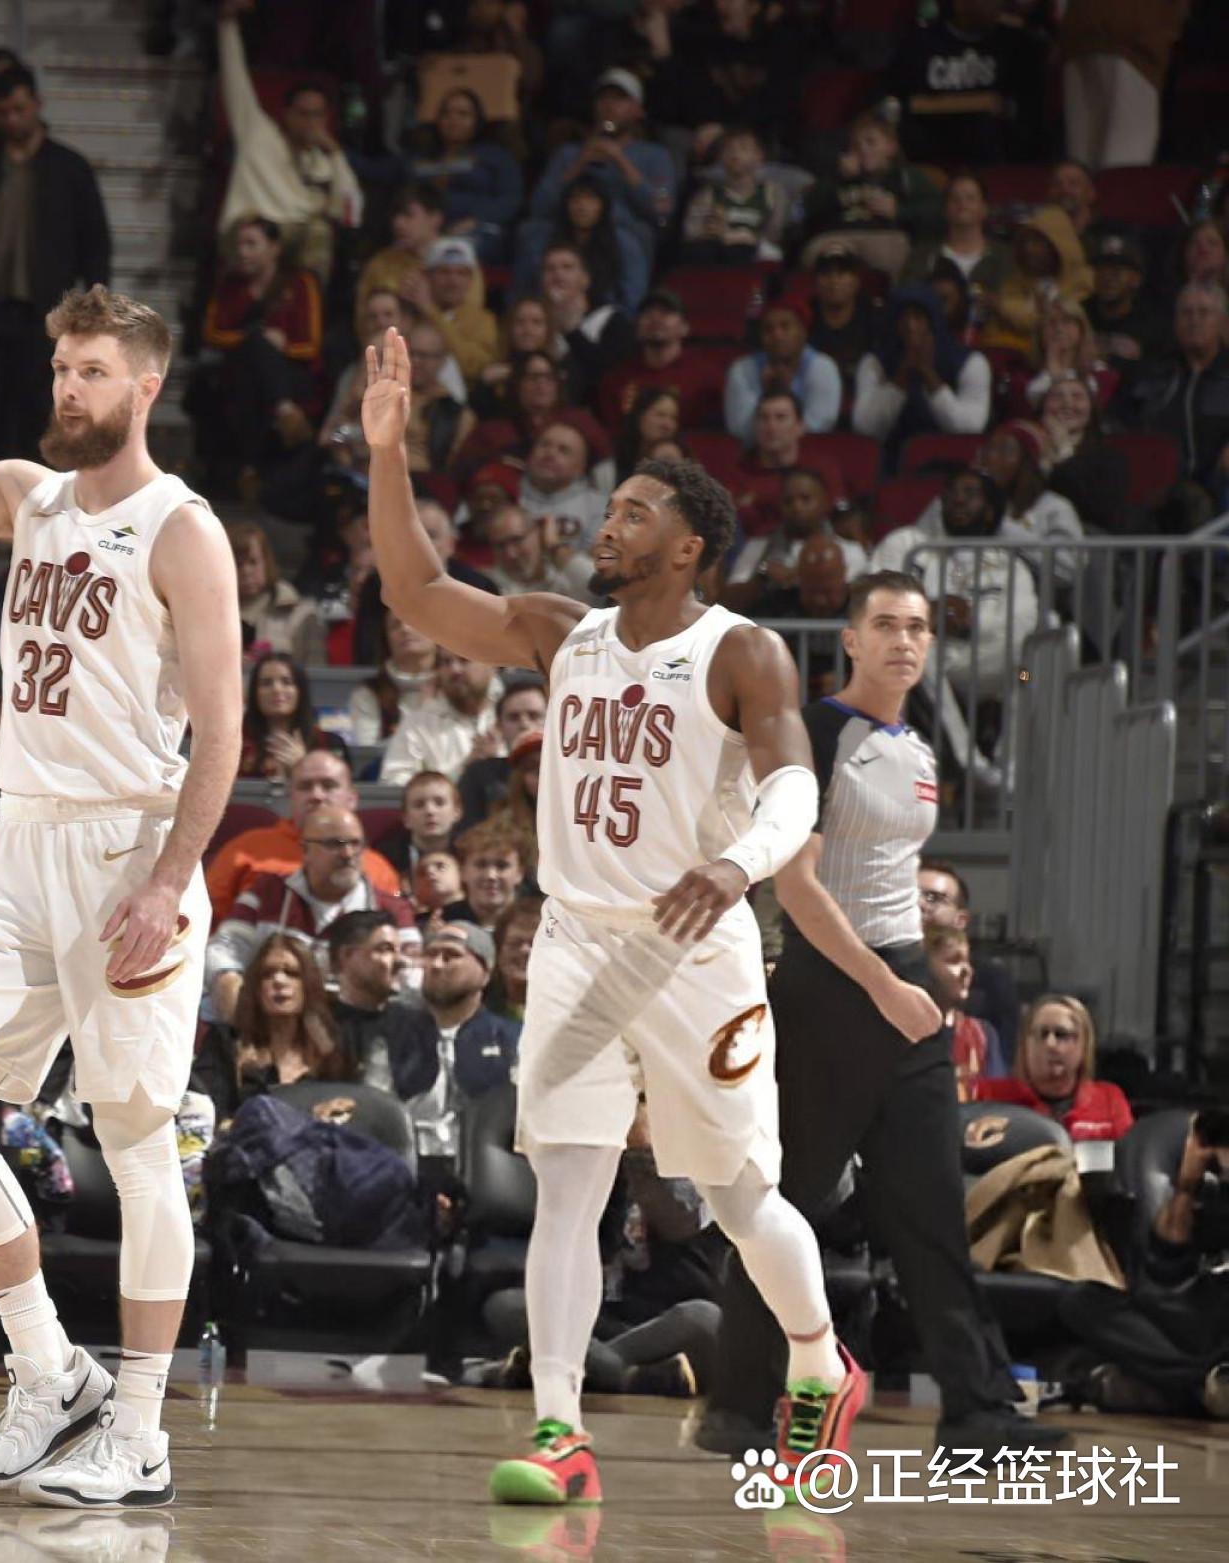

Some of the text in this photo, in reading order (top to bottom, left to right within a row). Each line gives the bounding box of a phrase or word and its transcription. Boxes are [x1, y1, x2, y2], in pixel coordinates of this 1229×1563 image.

[98, 540, 134, 556] CLIFFS
[9, 558, 117, 640] CAVS
[11, 640, 72, 716] 32
[652, 671, 691, 681] CLIFFS
[560, 694, 675, 768] CAVS
[574, 774, 643, 847] 45
